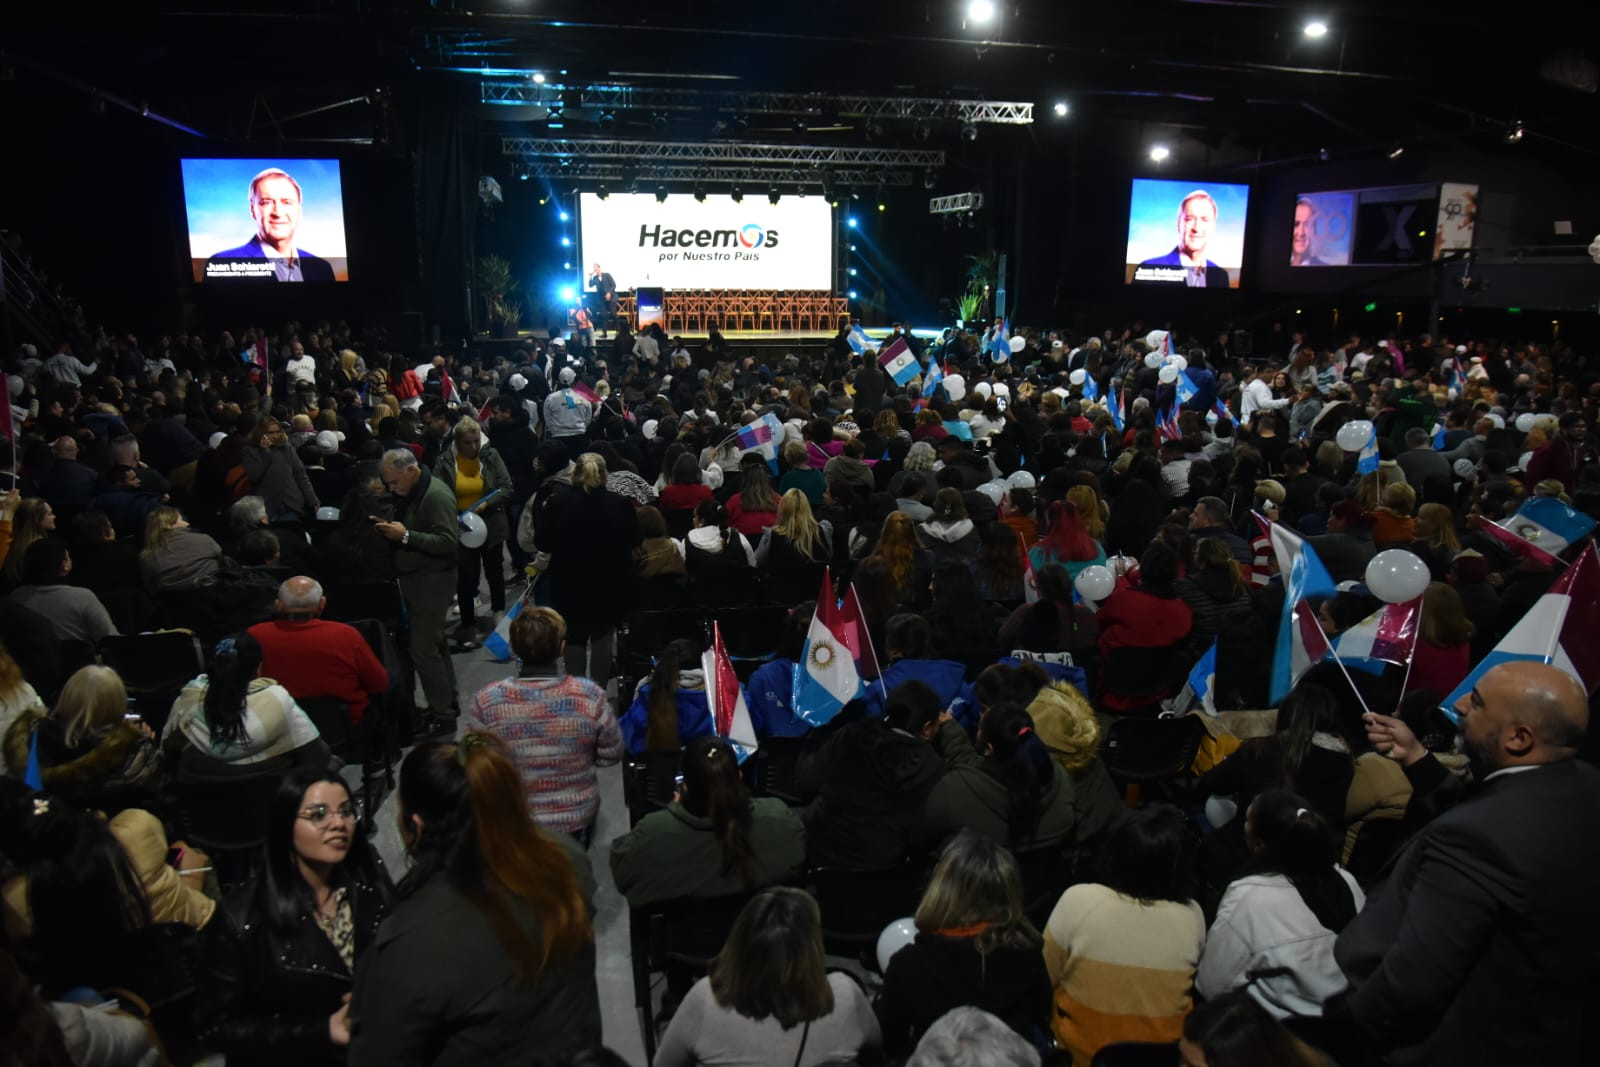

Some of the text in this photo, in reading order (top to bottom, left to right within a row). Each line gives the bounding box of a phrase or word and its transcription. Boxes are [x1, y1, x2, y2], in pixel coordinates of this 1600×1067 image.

[658, 252, 679, 263] por
[683, 251, 731, 261] Nuestro
[206, 262, 230, 271] Juan
